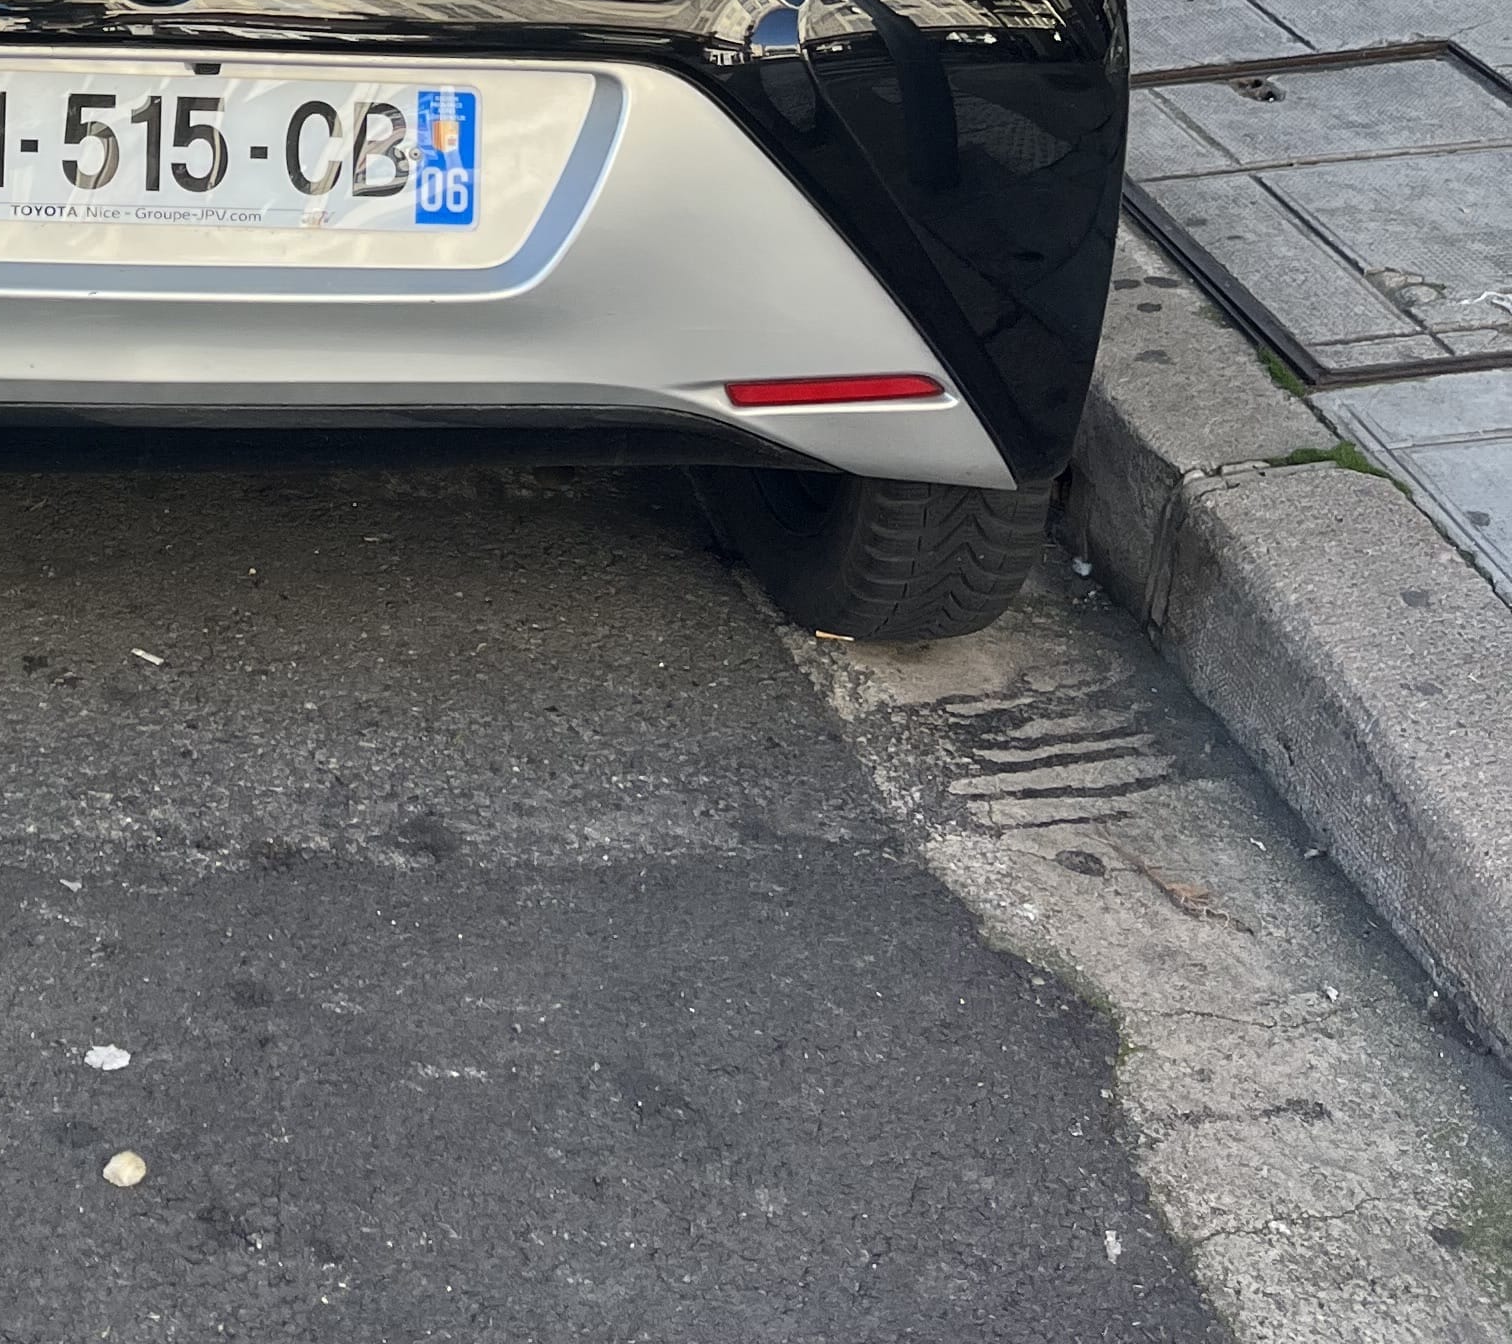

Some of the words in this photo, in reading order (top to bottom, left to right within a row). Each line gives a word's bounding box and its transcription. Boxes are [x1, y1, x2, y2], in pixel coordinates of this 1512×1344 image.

[420, 165, 470, 214] 06
[10, 203, 78, 219] TOYOTA
[86, 204, 122, 219] Nice
[134, 205, 262, 223] Groupe-JPV.com
